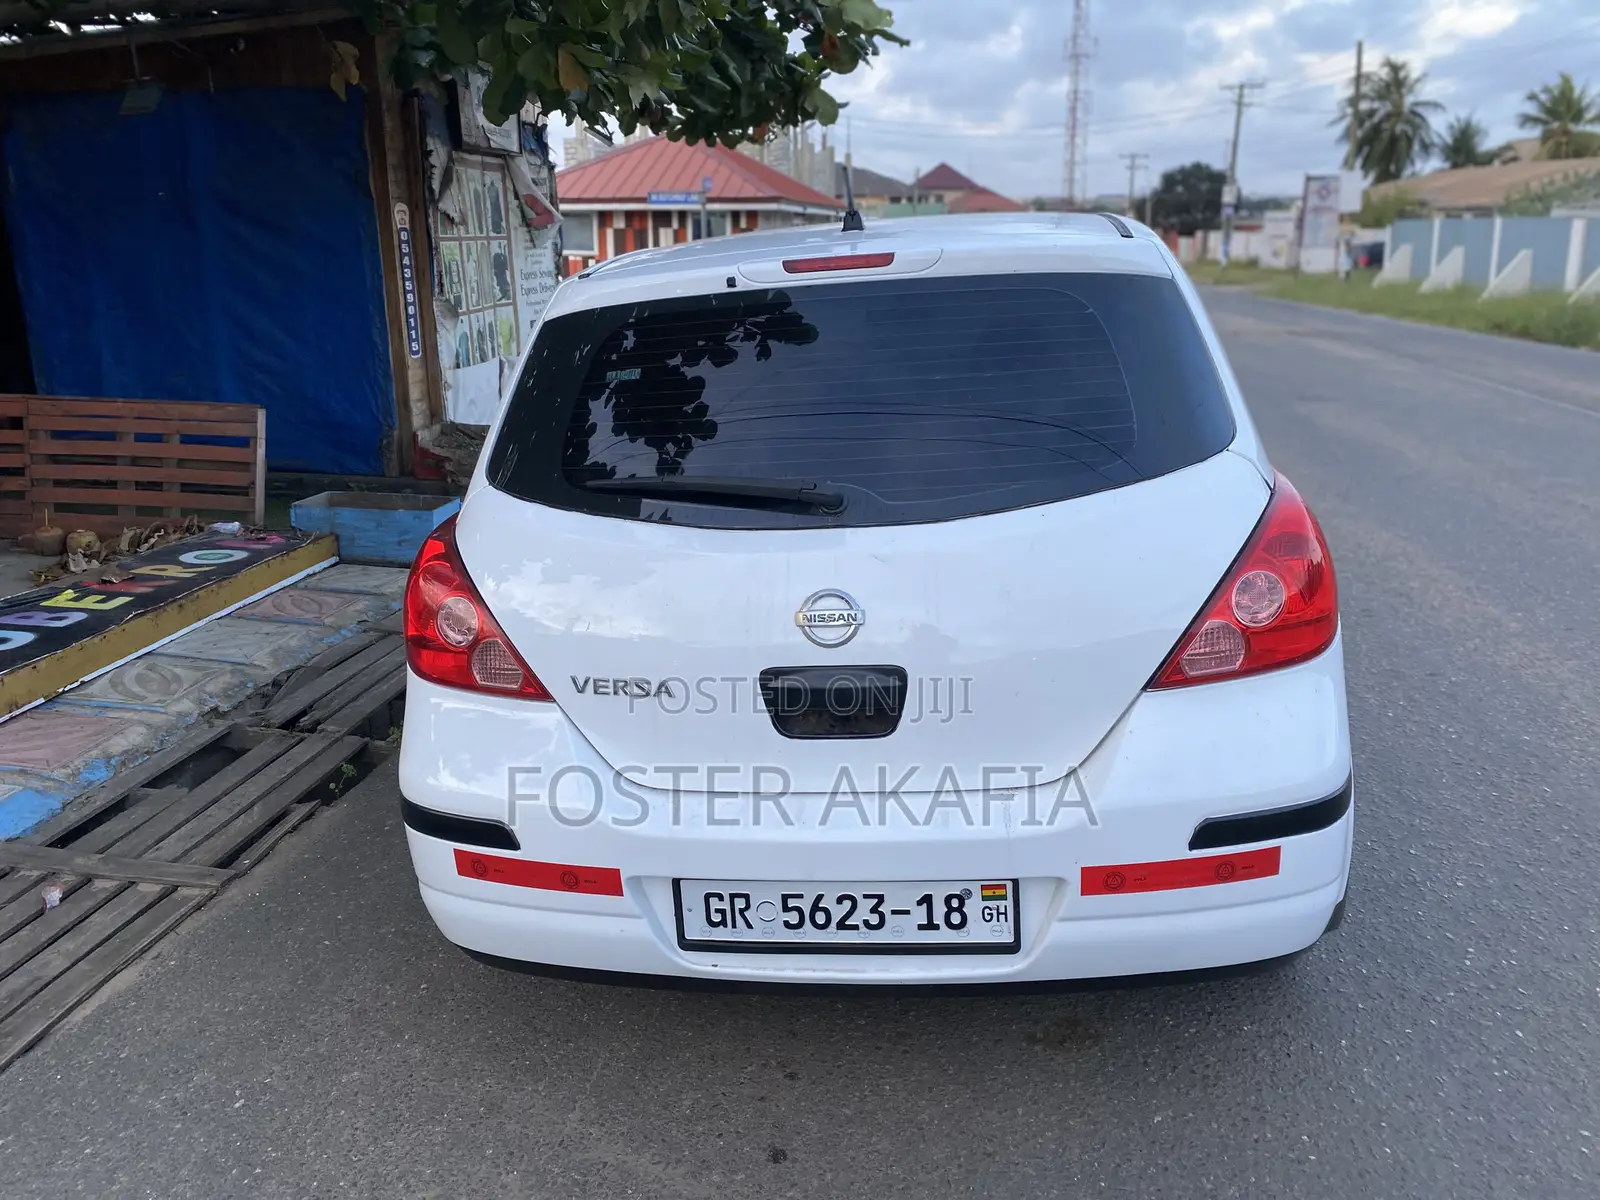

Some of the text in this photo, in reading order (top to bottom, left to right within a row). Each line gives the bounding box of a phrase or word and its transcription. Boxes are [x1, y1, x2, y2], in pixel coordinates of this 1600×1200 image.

[400, 231, 420, 351] 0543590115
[802, 613, 857, 623] NISSAN
[570, 675, 676, 699] VERSA
[703, 891, 969, 932] GR 5623-18
[982, 904, 1008, 923] GH
